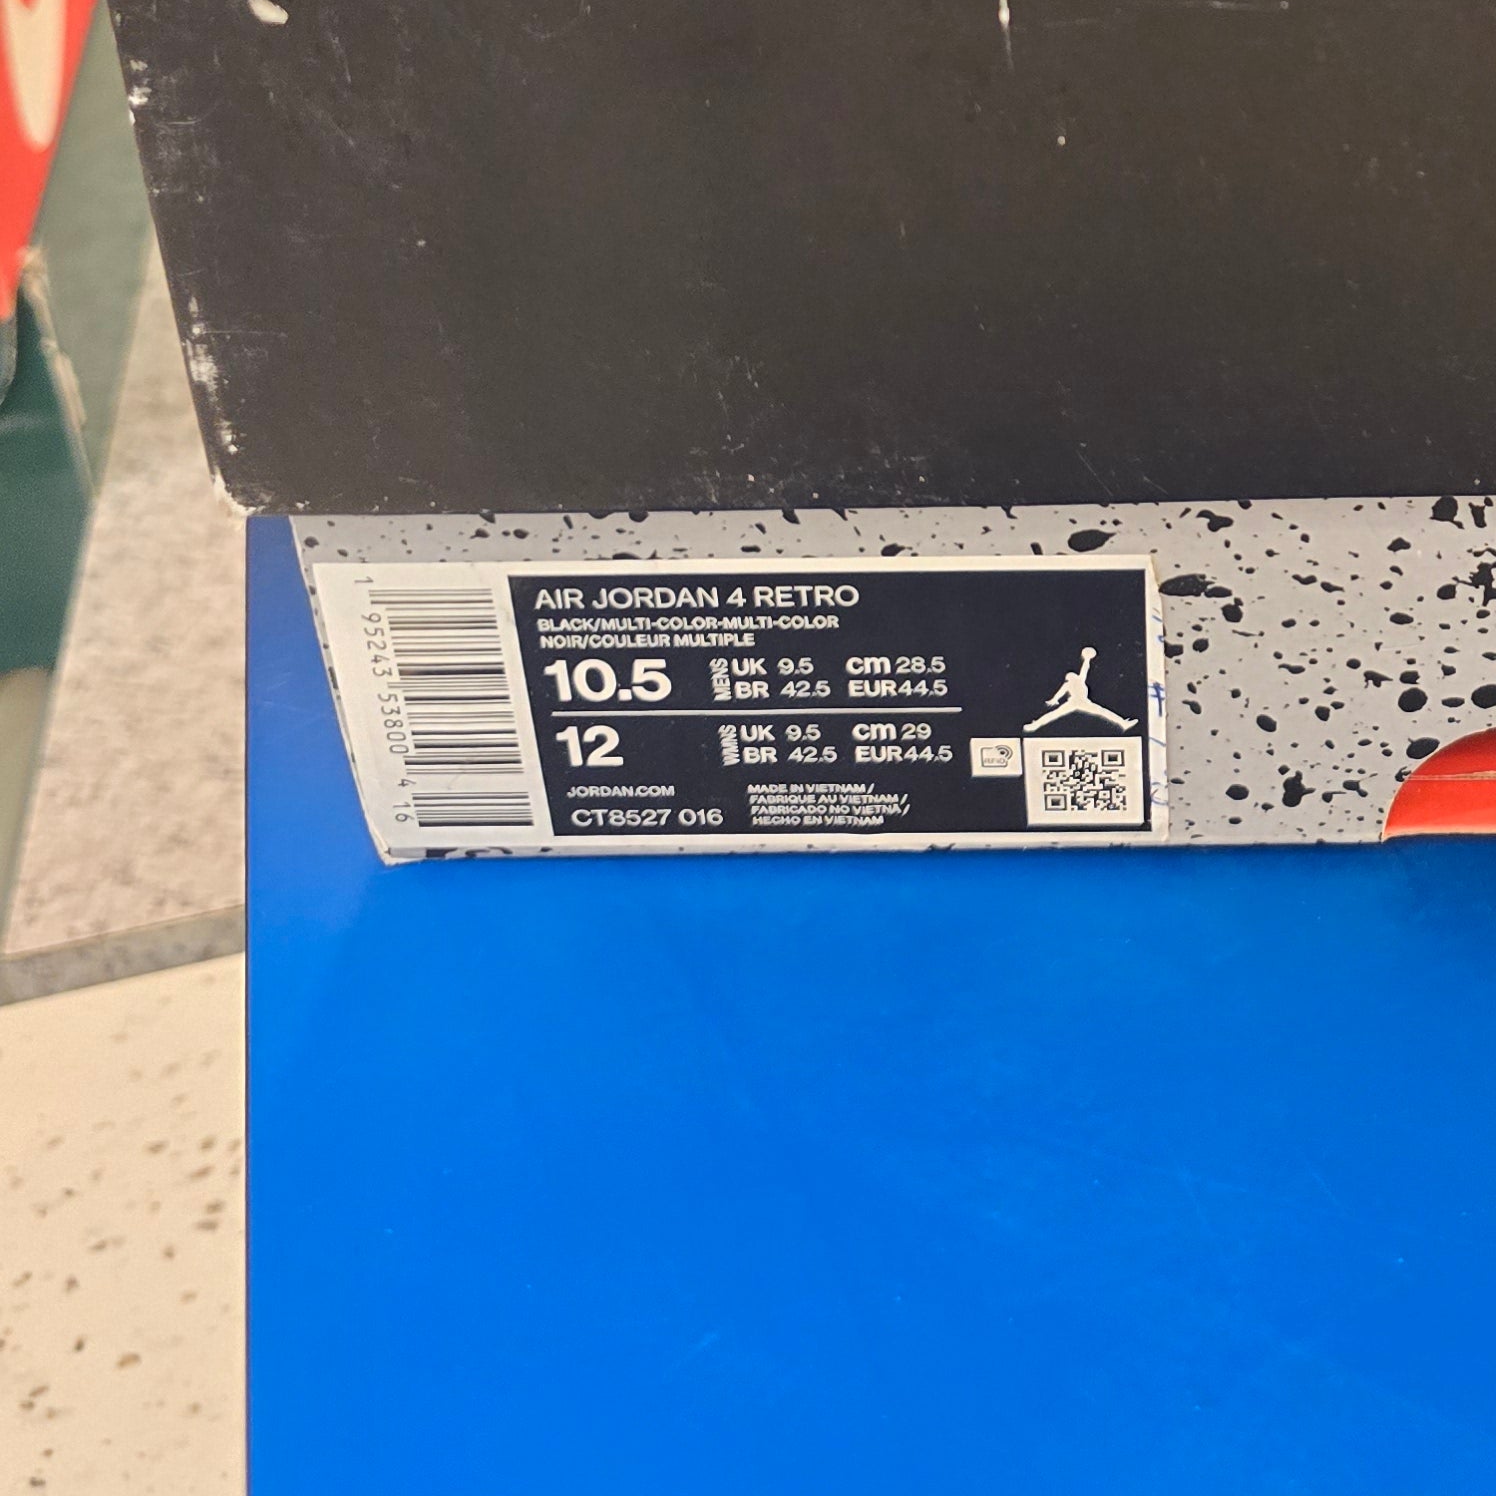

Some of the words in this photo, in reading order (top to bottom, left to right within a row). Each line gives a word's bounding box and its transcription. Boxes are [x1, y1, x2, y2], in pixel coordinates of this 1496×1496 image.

[534, 587, 585, 610] AIR
[591, 586, 719, 610] JORDAN
[726, 585, 747, 608] 4
[753, 584, 861, 608] RETRO
[536, 614, 840, 633] BLACK/MULTI-COLOR-MULTI-COLOR
[539, 632, 671, 650] NOIR/COULEUR
[674, 632, 756, 648] MULTIPLE
[731, 657, 768, 677] UK
[777, 656, 814, 675] 9.5
[845, 656, 892, 675] cm
[895, 655, 947, 674] 28.5
[361, 612, 393, 678] 95243
[377, 692, 410, 755] 53800
[543, 658, 673, 703] 10.5
[709, 657, 732, 702] MENS
[734, 680, 770, 700] BR
[780, 679, 832, 698] 42.5
[740, 723, 776, 742] UK
[785, 723, 822, 742] 9.5
[852, 722, 898, 741] cm
[901, 722, 933, 740] 29
[555, 724, 624, 768] 12
[717, 724, 741, 767] WMNS
[743, 746, 778, 764] BR
[786, 745, 838, 764] 42.5
[566, 785, 676, 799] JORDAN.COM
[747, 783, 788, 794] MADE
[789, 783, 804, 793] IN
[749, 794, 817, 805] FABRIQUE
[817, 794, 838, 804] AU
[571, 808, 673, 828] CT8527
[678, 807, 725, 827] 016
[751, 805, 828, 816] FABRICADO
[829, 805, 850, 815] NO
[752, 815, 801, 826] HECHO
[802, 815, 823, 825] EN
[823, 814, 885, 826] VIETNAM
